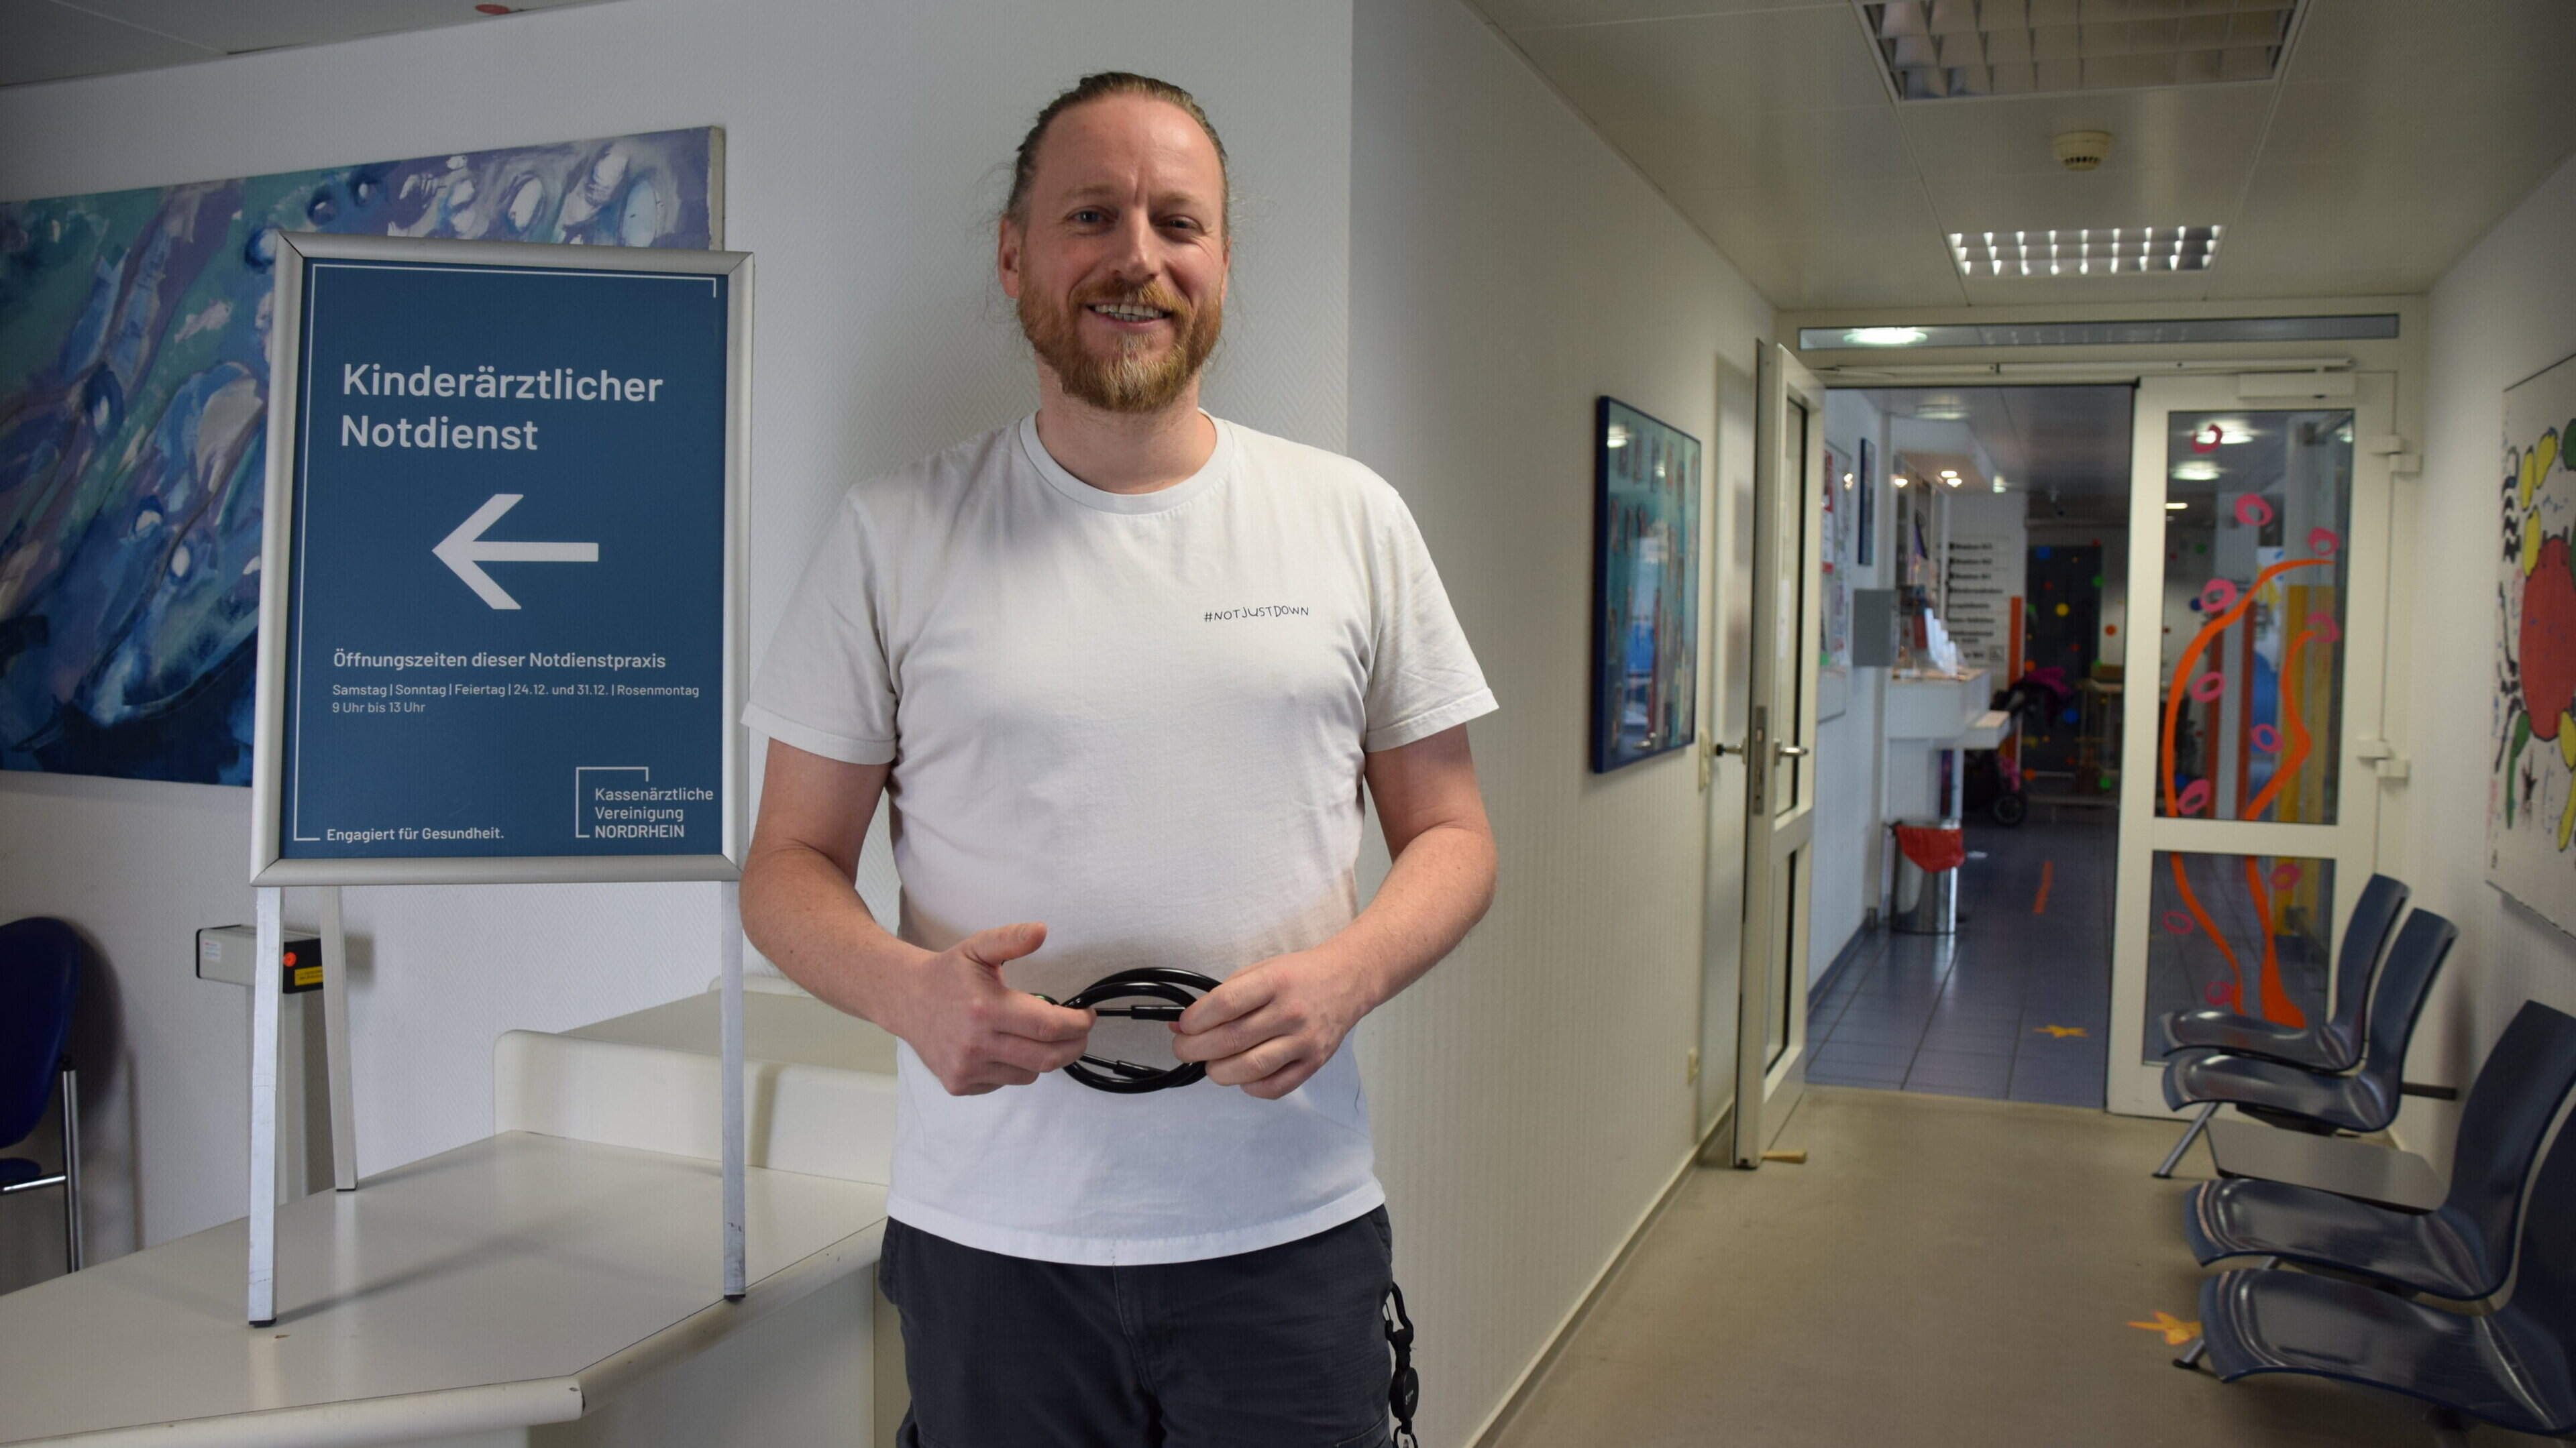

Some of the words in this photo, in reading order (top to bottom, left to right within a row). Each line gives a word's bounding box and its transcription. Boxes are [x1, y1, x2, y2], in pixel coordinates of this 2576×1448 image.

[343, 363, 664, 402] Kinderärztlicher
[341, 414, 538, 451] Notdienst
[1203, 604, 1310, 623] #NOTJUSTDOWN
[333, 648, 468, 671] Öffnungszeiten
[472, 651, 526, 667] dieser
[529, 652, 666, 671] Notdienstpraxis
[332, 684, 387, 698] Samstag
[395, 684, 447, 698] Sonntag
[454, 683, 506, 698] Feiertag
[513, 683, 547, 695] 24.12.
[551, 684, 575, 695] und
[577, 684, 608, 695] 31.12.
[616, 684, 700, 698] Rosenmontag
[332, 702, 340, 714] 9
[343, 702, 366, 713] Uhr
[368, 702, 386, 713] bis
[388, 702, 401, 713] 13
[404, 702, 426, 713] Uhr
[595, 787, 714, 801] Kassenärztliche
[594, 806, 684, 823] Vereinigung
[327, 828, 395, 844] Engagiert
[398, 827, 419, 840] für
[422, 826, 504, 840] Gesundheit.
[595, 824, 684, 838] NORDRHEIN
